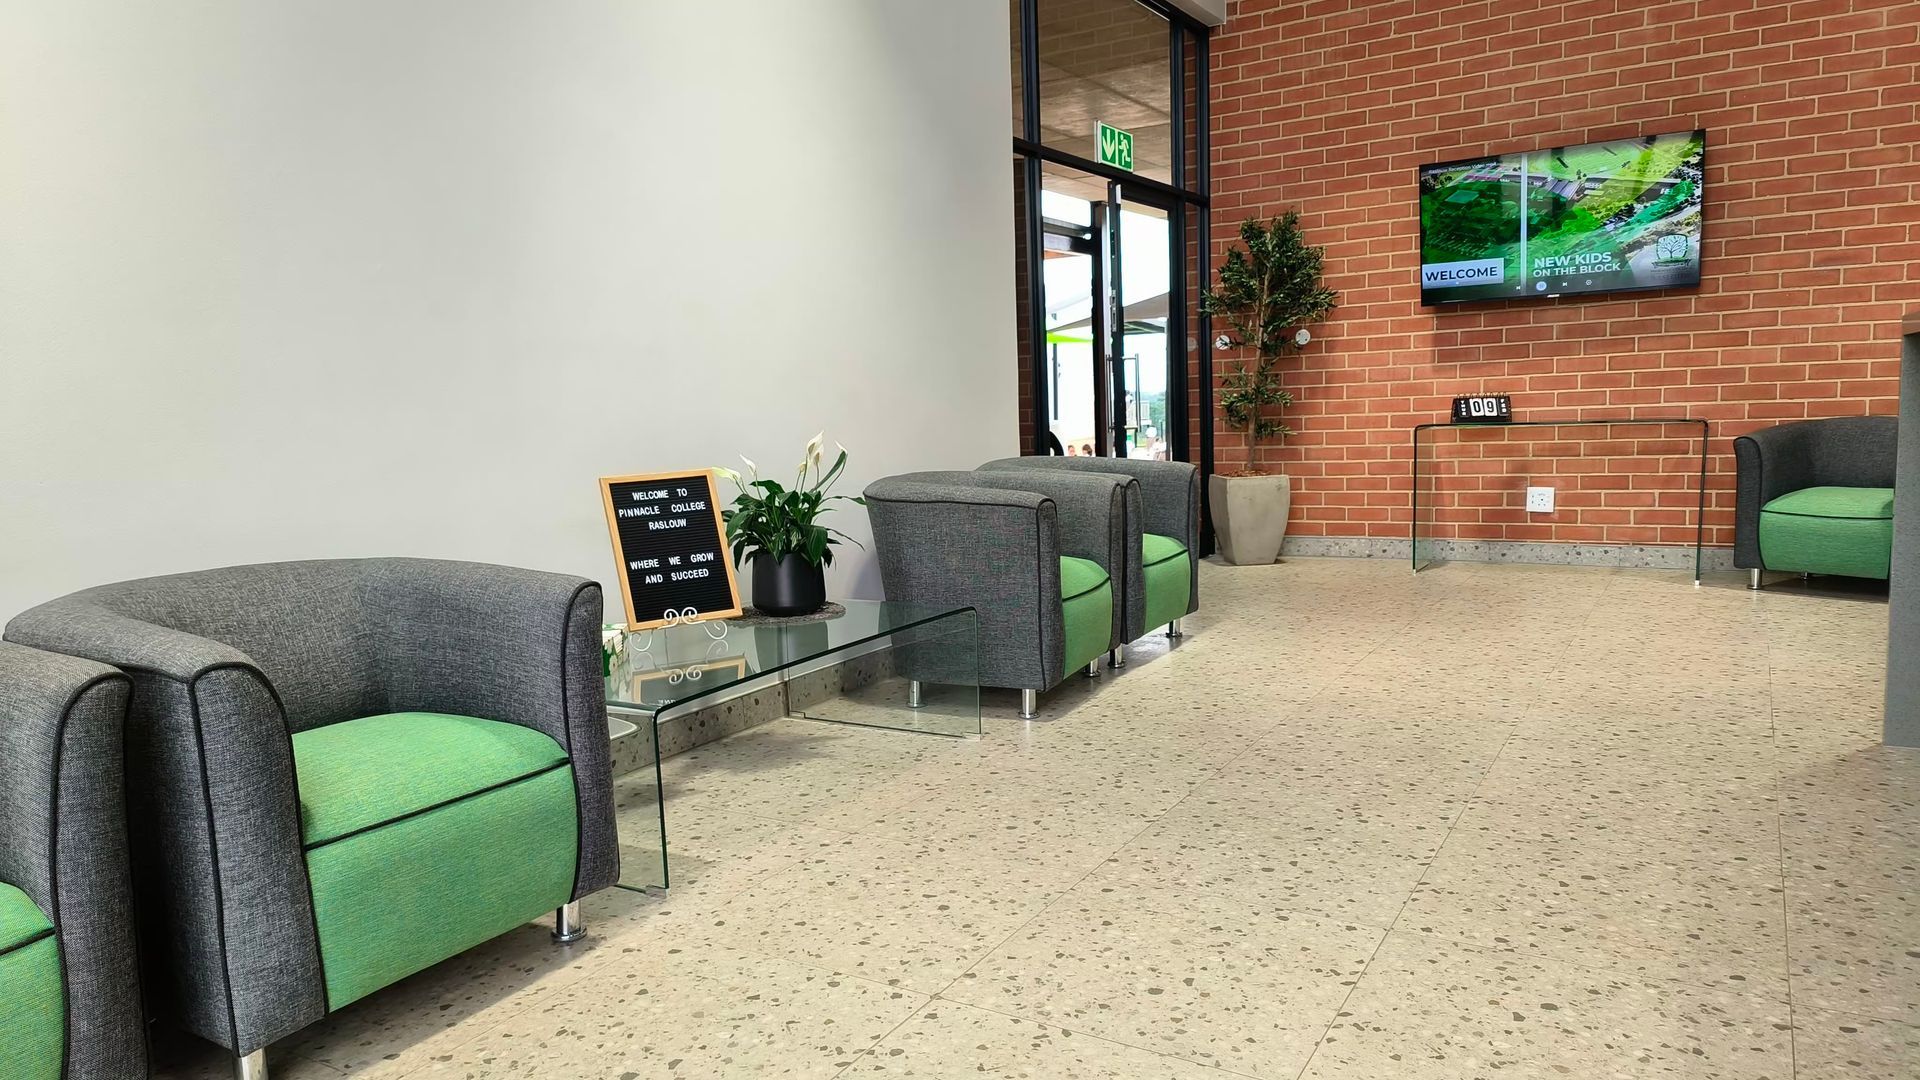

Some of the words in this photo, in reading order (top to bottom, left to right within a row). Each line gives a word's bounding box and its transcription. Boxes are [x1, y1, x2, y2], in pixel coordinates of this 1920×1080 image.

[1534, 255, 1571, 268] NEW
[1575, 252, 1612, 265] KIDS
[1425, 266, 1498, 281] WELCOME
[1533, 268, 1551, 278] ON
[1553, 266, 1577, 275] THE
[1580, 263, 1621, 274] BLOCK
[1473, 400, 1494, 413] 09
[632, 489, 669, 501] WELCOME
[676, 488, 688, 497] TO
[618, 505, 660, 518] PINNACLE
[671, 501, 706, 513] COLLEGE
[649, 518, 687, 530] RASLOUW
[630, 559, 660, 570] WHERE
[668, 556, 681, 566] WE
[690, 552, 714, 563] GROW
[645, 574, 663, 584] AND
[671, 568, 709, 581] SUCCEED
